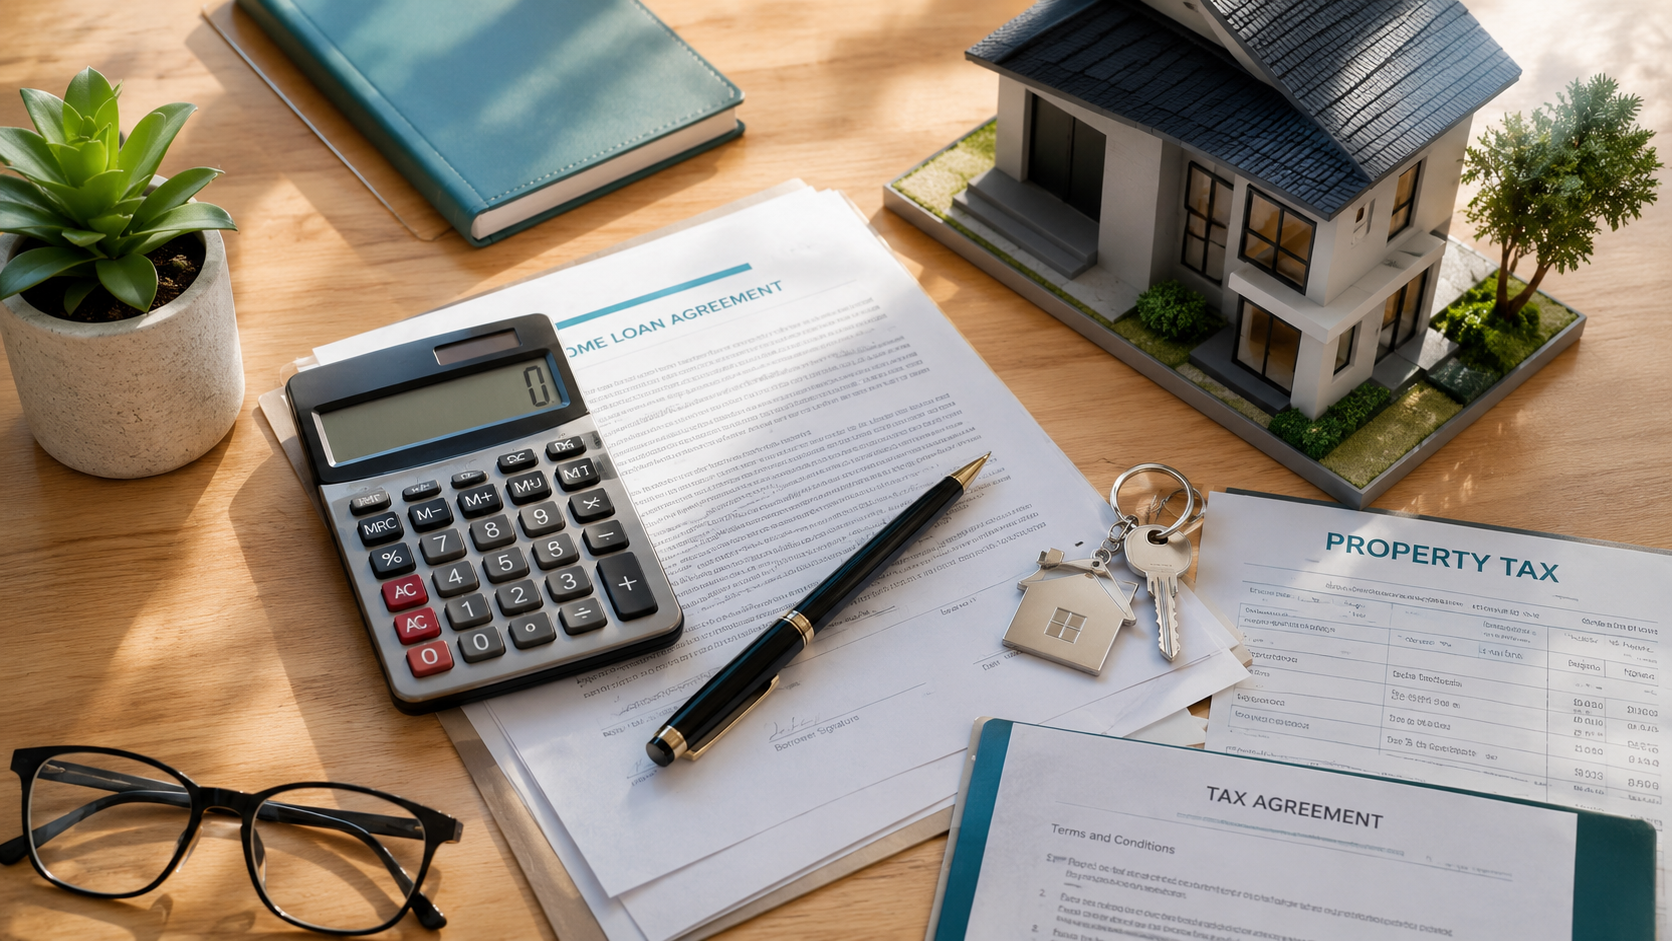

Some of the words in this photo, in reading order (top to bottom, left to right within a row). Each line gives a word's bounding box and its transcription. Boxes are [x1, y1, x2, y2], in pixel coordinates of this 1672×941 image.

[566, 335, 608, 358] OME
[610, 318, 666, 344] LOAN
[671, 279, 784, 326] AGREEMENT
[523, 365, 550, 407] 0
[464, 491, 493, 507] M+
[363, 517, 397, 536] MRC
[484, 521, 500, 538] 8
[432, 534, 447, 553] 7
[381, 549, 403, 567] %
[498, 554, 514, 571] 5
[1326, 531, 1492, 573] PROPERTY
[1500, 556, 1560, 584] TAX
[448, 567, 463, 584] 4
[560, 573, 577, 590] 3
[395, 583, 417, 600] AC
[510, 586, 528, 604] 2
[461, 600, 475, 618] 1
[406, 615, 428, 634] AC
[1207, 785, 1248, 807] TAX
[1252, 794, 1384, 830] AGREEMENT
[1051, 823, 1087, 839] Terms
[1089, 832, 1112, 844] and
[1114, 834, 1176, 855] Conditions
